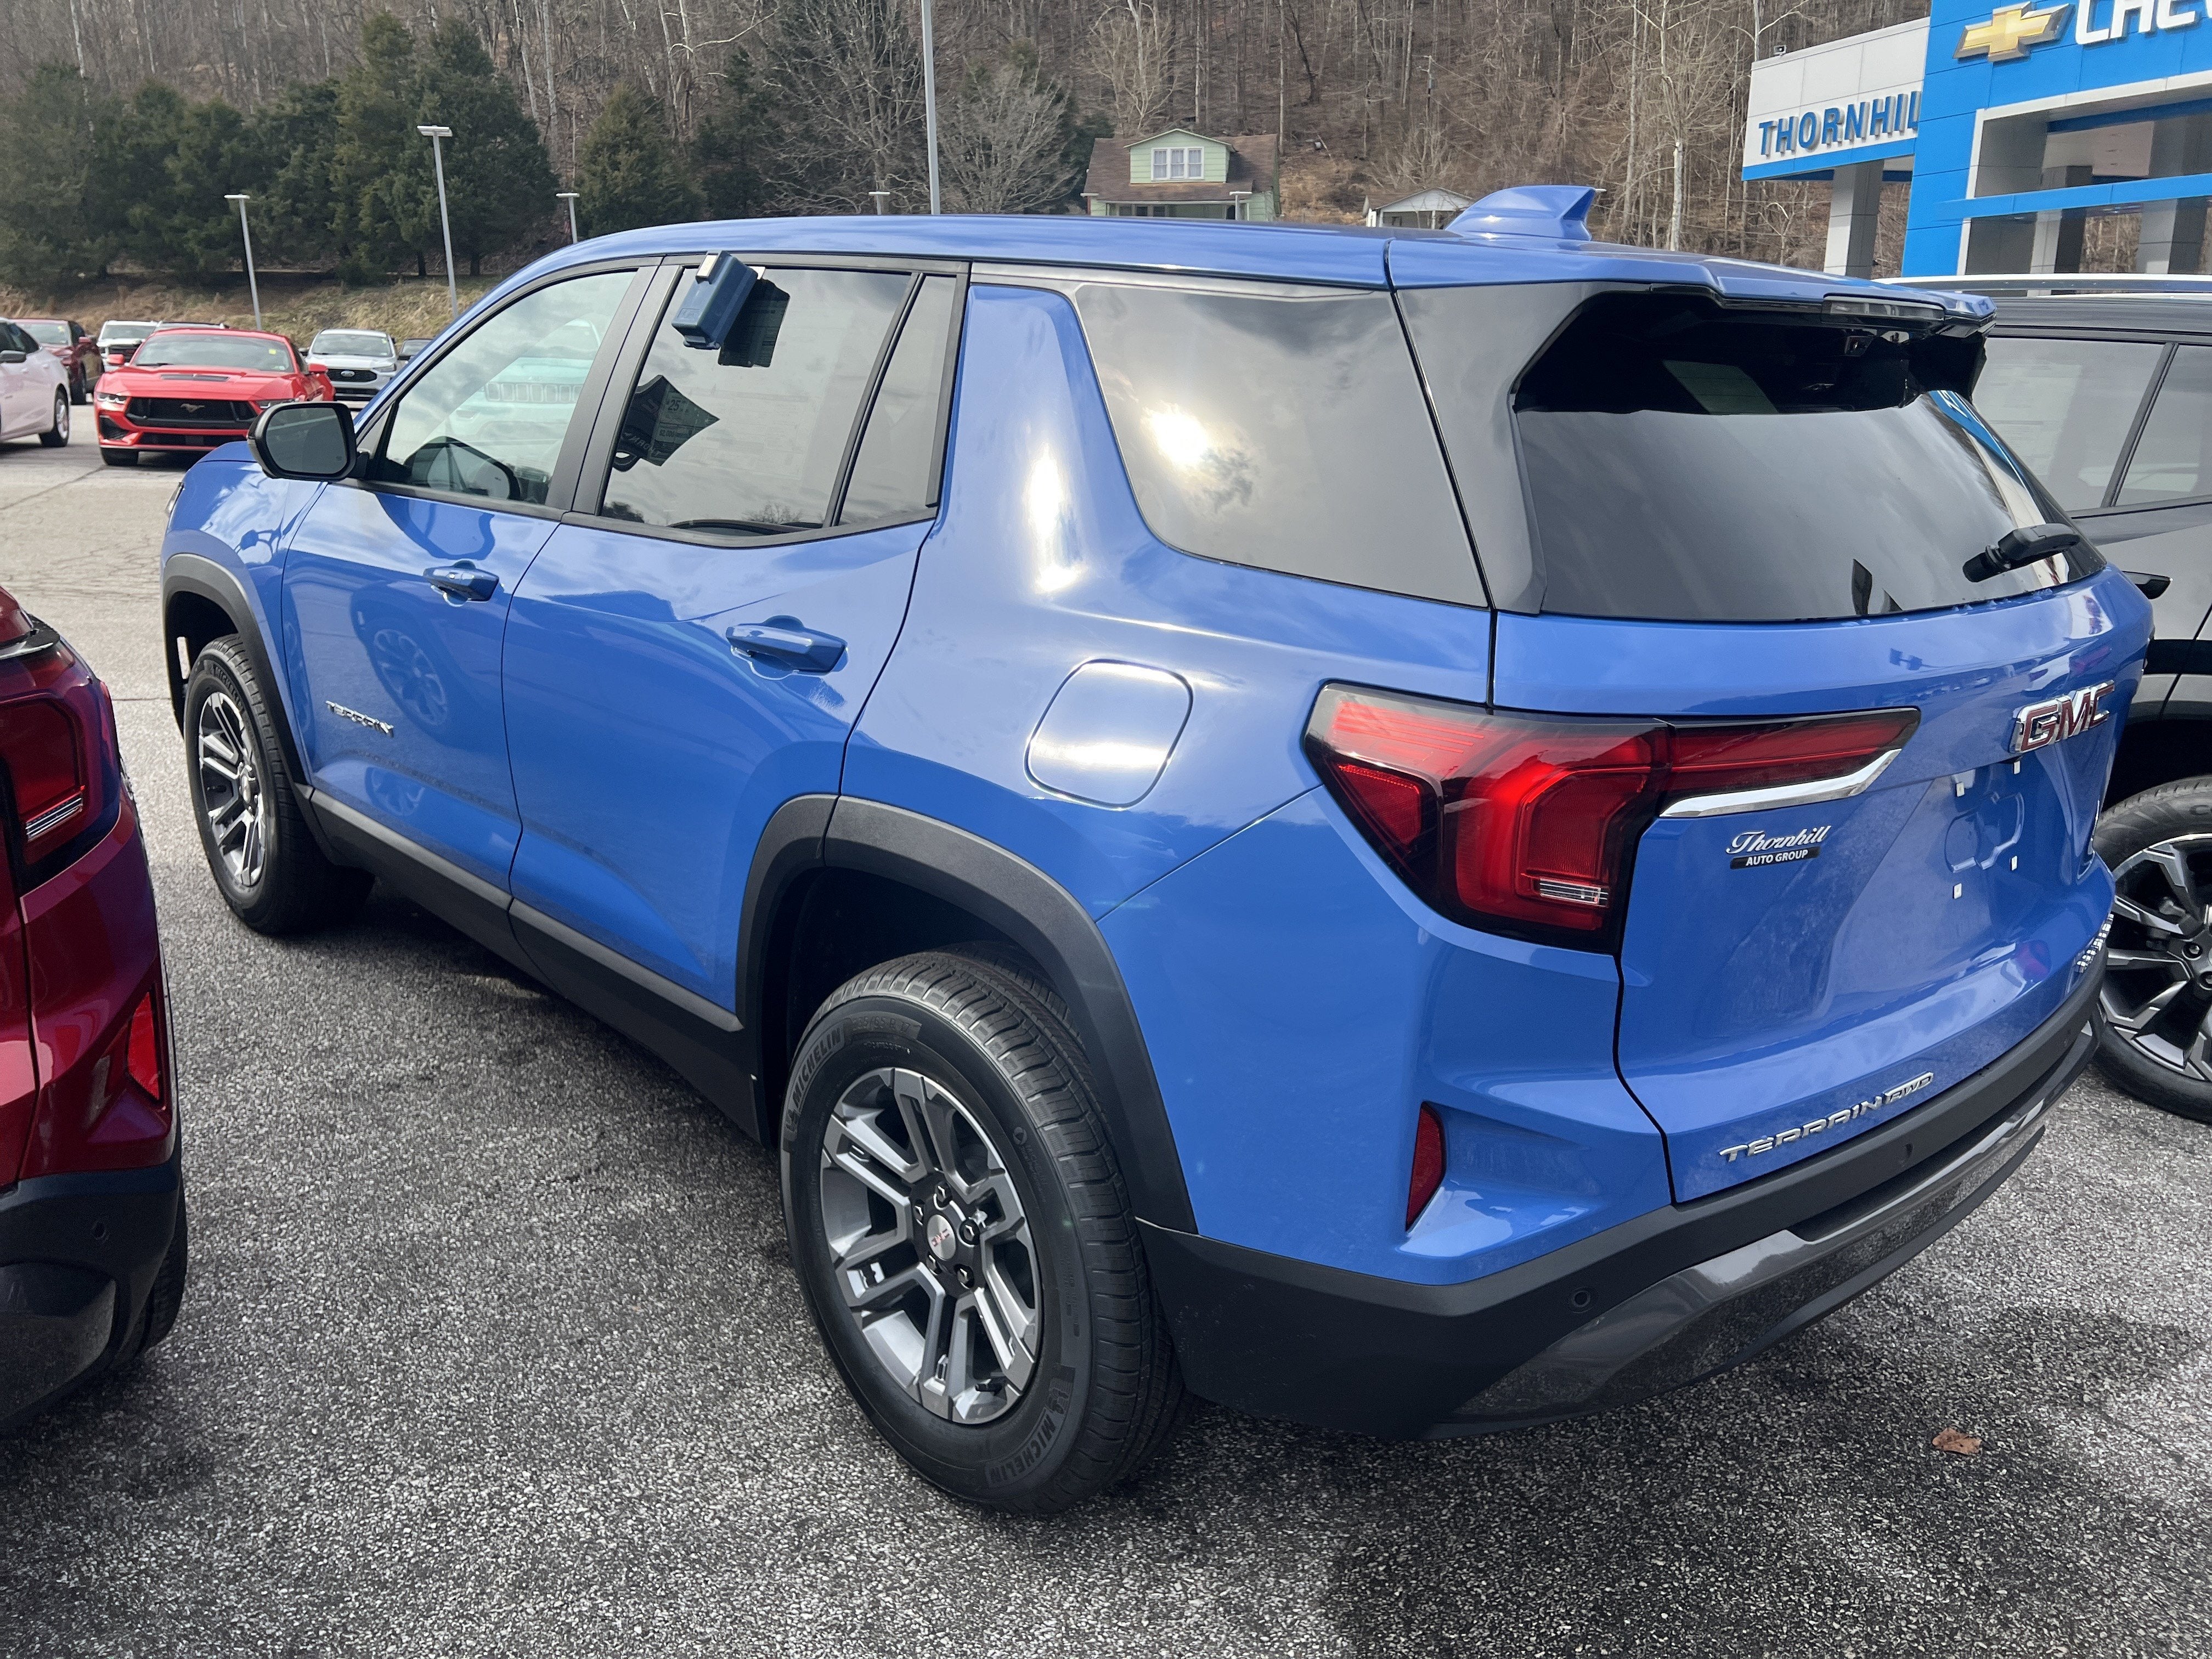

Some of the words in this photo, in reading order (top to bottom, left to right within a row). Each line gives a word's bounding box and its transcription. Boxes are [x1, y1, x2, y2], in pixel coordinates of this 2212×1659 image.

[2075, 0, 2212, 44] CH
[325, 700, 394, 737] TERRAIN
[2010, 680, 2115, 753] GMC
[1725, 825, 1832, 855] Thornhill
[1745, 855, 1774, 866] AUTO
[1775, 849, 1808, 862] GROUP
[793, 1027, 841, 1108] MICHELIN
[1718, 1095, 1883, 1162] TERRAIN
[1883, 1071, 1934, 1105] AWD
[932, 1228, 950, 1248] GMC
[989, 1413, 1056, 1481] MICHELIN
